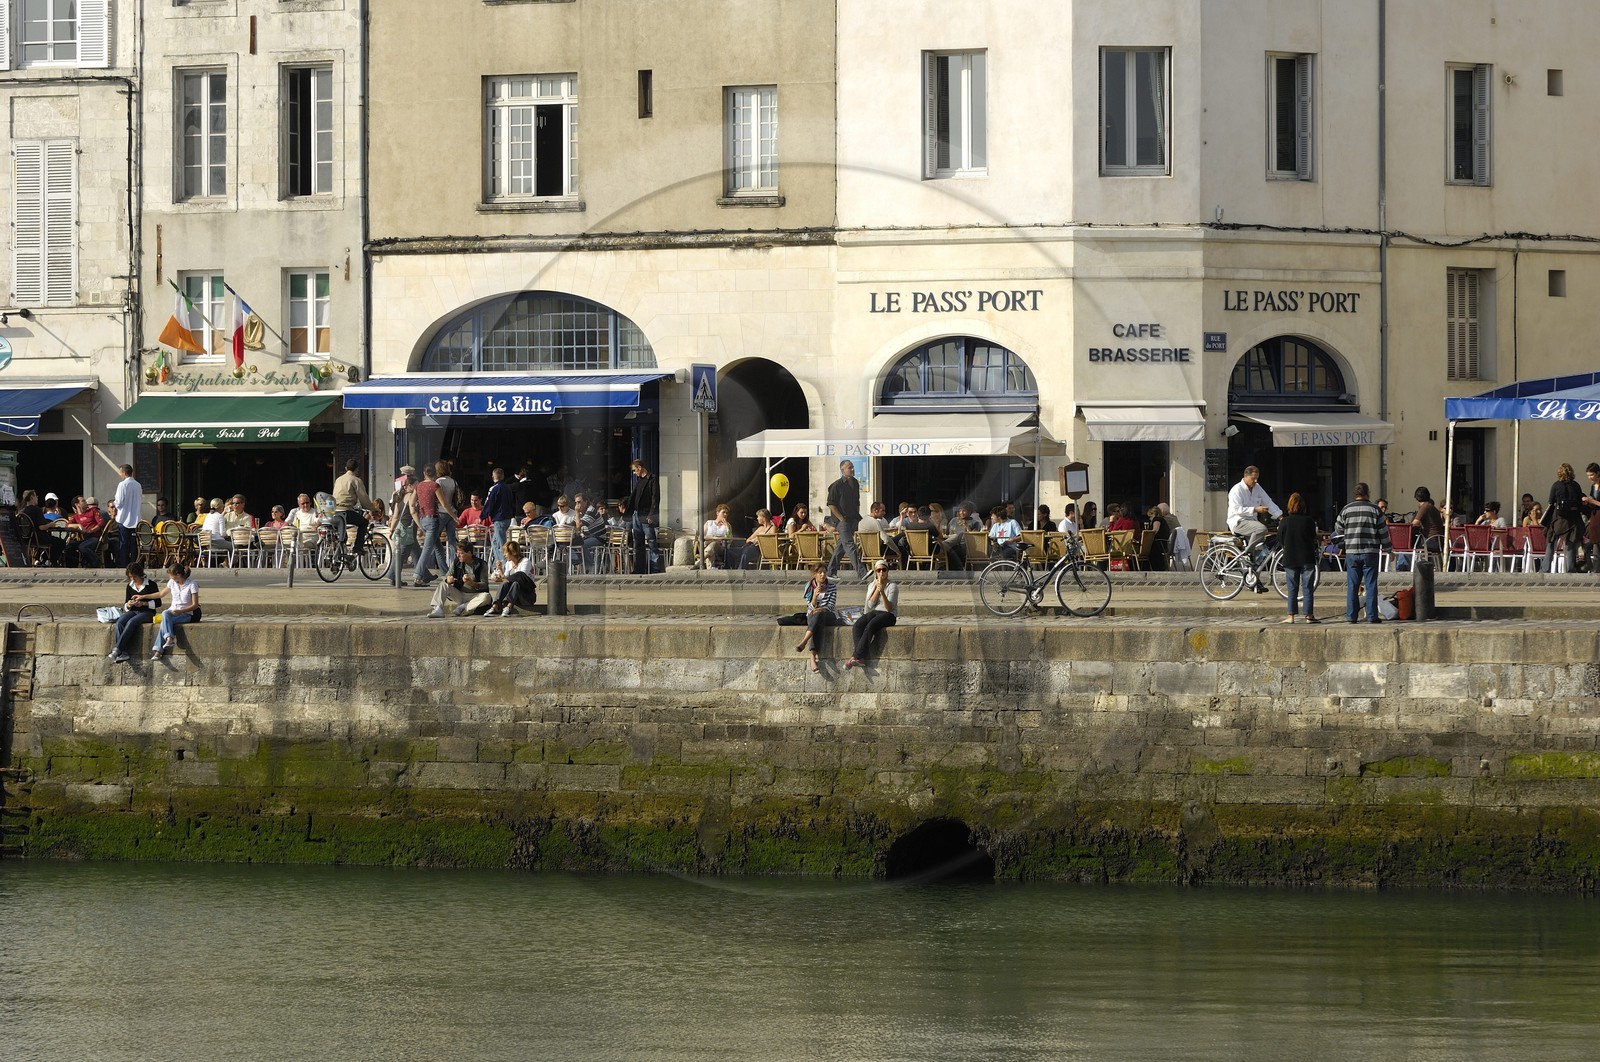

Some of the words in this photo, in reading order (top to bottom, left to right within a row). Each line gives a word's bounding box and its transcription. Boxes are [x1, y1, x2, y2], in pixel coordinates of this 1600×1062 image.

[870, 292, 901, 313] LE
[977, 290, 1043, 312] PORT
[1224, 290, 1248, 312] LE
[1308, 292, 1360, 313] PORT
[1112, 323, 1161, 338] CAFE
[1212, 342, 1226, 350] PORT
[1089, 348, 1190, 362] BRASSERIE
[262, 371, 302, 386] Irish
[429, 396, 470, 413] Café
[486, 396, 507, 412] Le
[511, 396, 552, 412] Zinc
[137, 428, 205, 442] Fitzpatrick's
[216, 428, 245, 439] Irish
[257, 428, 280, 438] Pub
[1294, 432, 1309, 446] LE
[1345, 430, 1375, 444] PORT
[816, 444, 836, 456] LE
[890, 443, 931, 456] PORT
